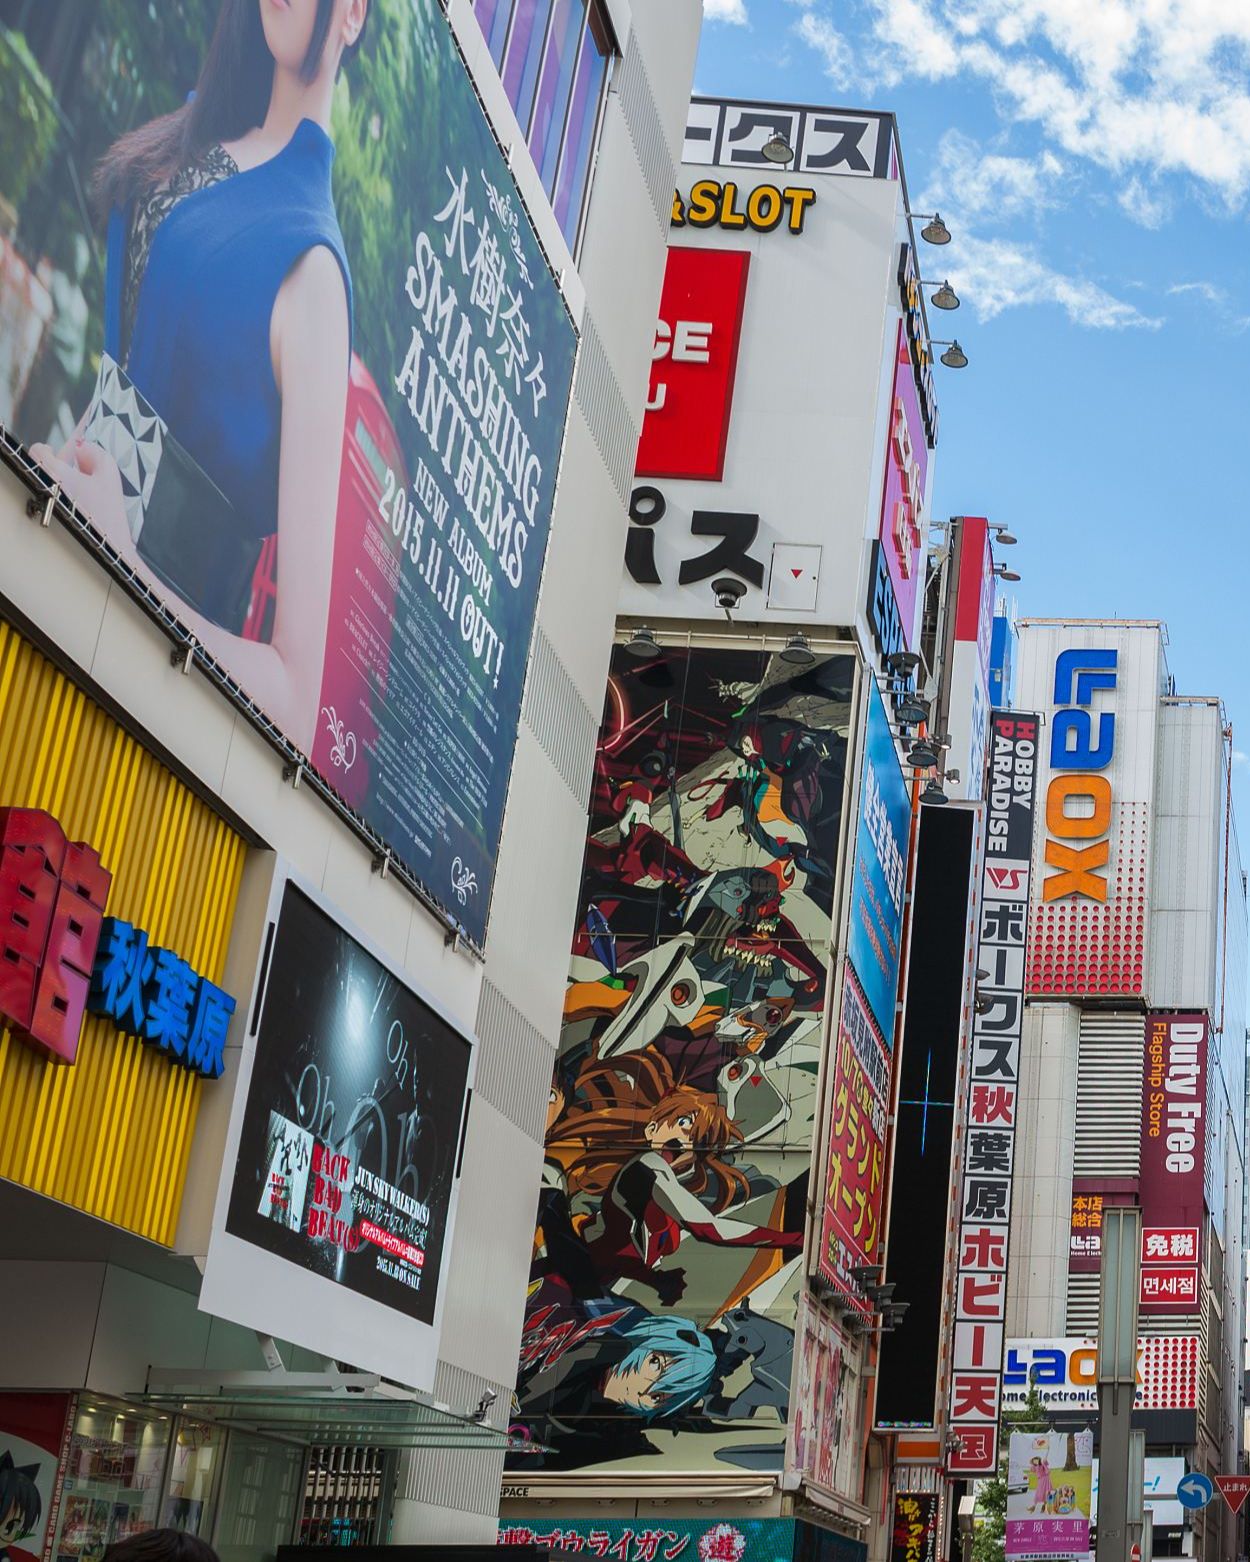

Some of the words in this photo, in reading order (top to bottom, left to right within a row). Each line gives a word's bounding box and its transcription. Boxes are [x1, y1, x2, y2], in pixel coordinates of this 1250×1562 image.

[433, 165, 547, 418] 水樹奈々
[405, 231, 542, 527] SMASHING
[395, 326, 529, 588] ANTHEMS
[413, 456, 450, 531] NEW
[448, 517, 494, 606] ALBUM
[378, 466, 460, 620] 2015.11.11
[460, 594, 505, 690] OUT!
[986, 719, 1015, 853] PARADISE
[1013, 720, 1037, 810] HOBBY
[1043, 648, 1119, 903] Laox
[95, 917, 237, 1079] 秋葉原
[1149, 1022, 1167, 1088] Flagship
[1164, 1022, 1204, 1096] Duty
[834, 1081, 883, 1195] グランド
[1149, 1093, 1165, 1138] Store
[1165, 1102, 1202, 1173] Free
[312, 1142, 350, 1184] BACK
[314, 1176, 343, 1215] BAD
[354, 1165, 375, 1195] JUN
[829, 1150, 878, 1254] オープン
[1073, 1196, 1104, 1211] 本店
[1145, 1233, 1194, 1258] 免税
[1143, 1277, 1195, 1298] 면세점
[1222, 1482, 1248, 1493] 止まれ
[1013, 1520, 1084, 1535] 茅原実里
